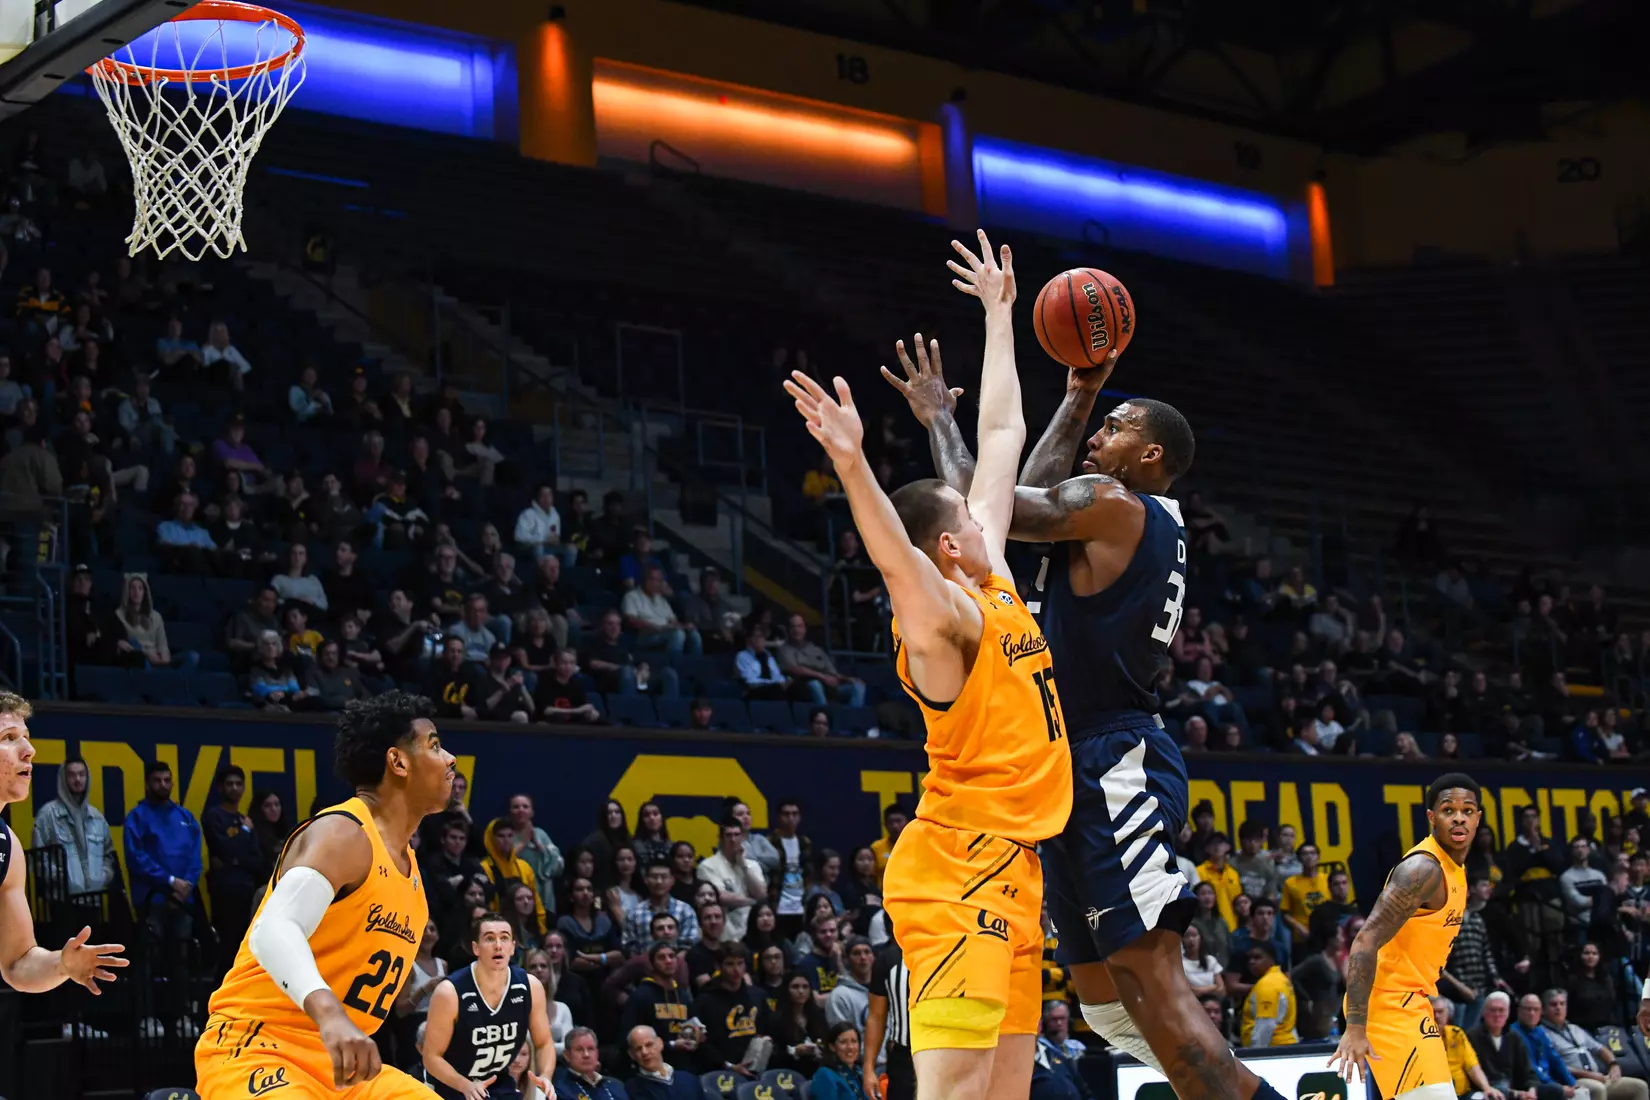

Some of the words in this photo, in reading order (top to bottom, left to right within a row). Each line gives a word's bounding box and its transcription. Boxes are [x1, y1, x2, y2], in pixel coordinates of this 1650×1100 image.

[836, 53, 870, 85] 18
[1556, 157, 1602, 183] 20
[1081, 282, 1110, 351] Wilson
[1112, 285, 1131, 334] NCAA
[1151, 570, 1186, 648] 3
[365, 903, 401, 932] Golden
[342, 949, 404, 1020] 22
[471, 1021, 518, 1046] CBU
[725, 1003, 758, 1039] Cal
[468, 1042, 515, 1077] 25
[248, 1067, 290, 1097] Cal
